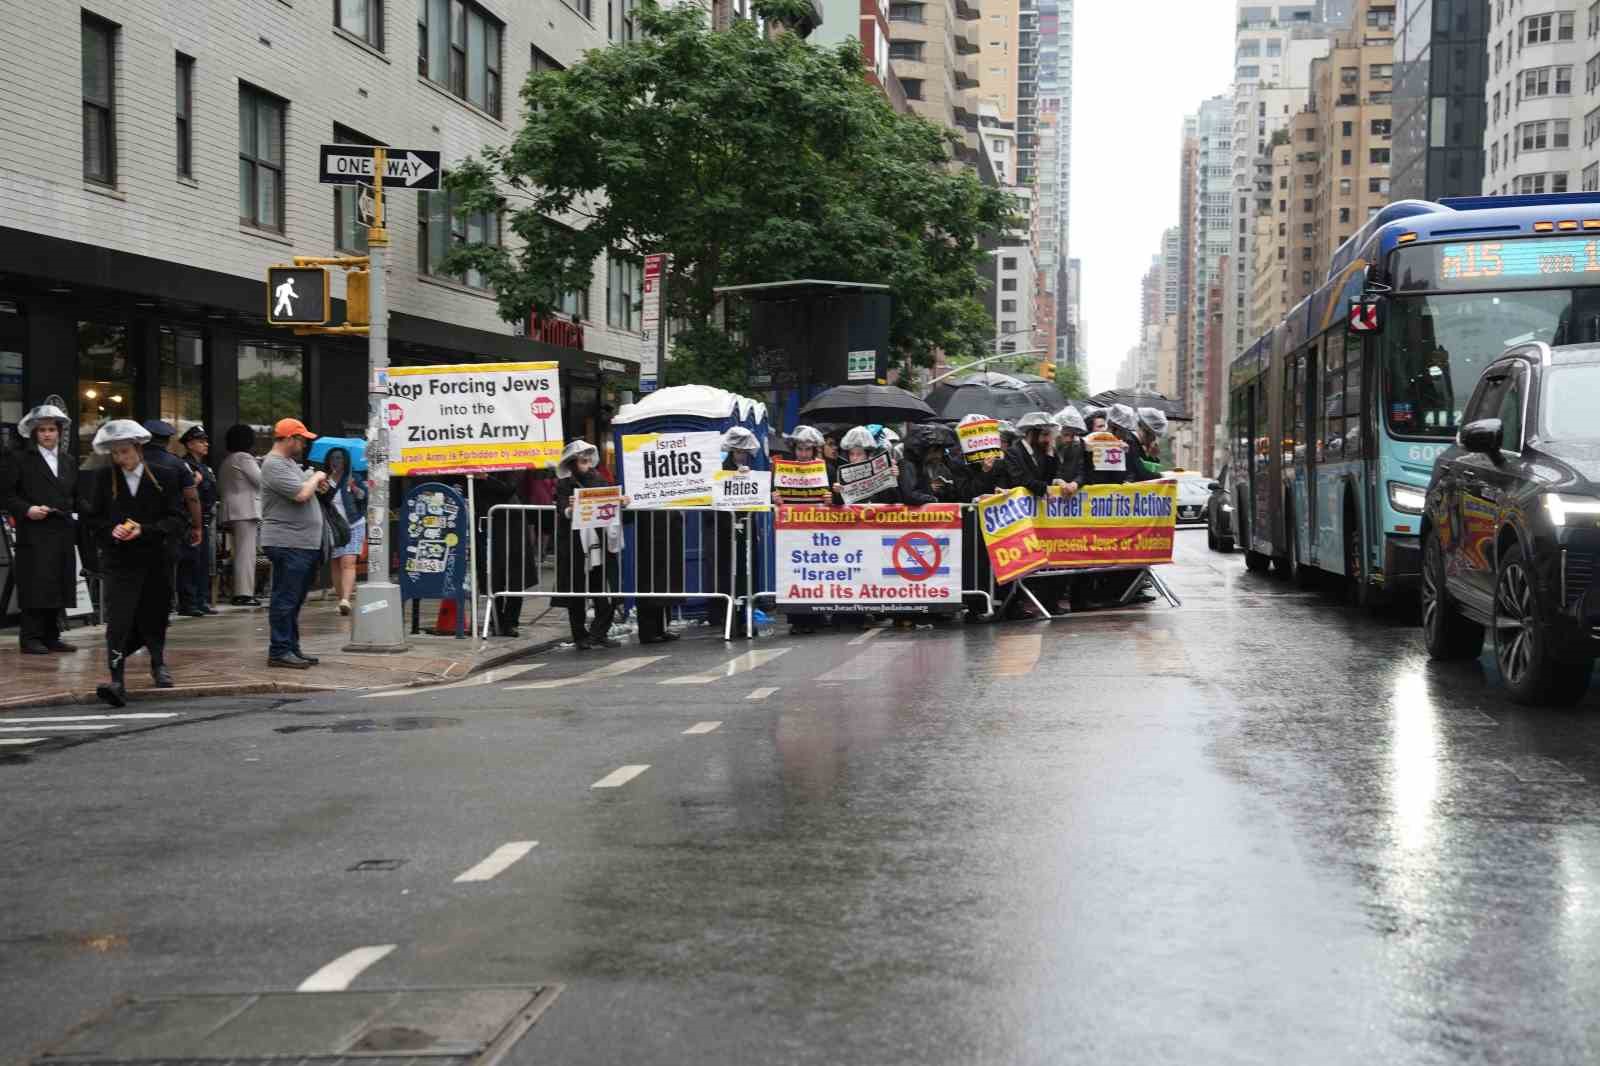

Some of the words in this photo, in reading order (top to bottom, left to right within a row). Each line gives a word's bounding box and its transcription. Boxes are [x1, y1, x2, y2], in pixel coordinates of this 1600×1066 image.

[337, 158, 371, 174] ONE
[387, 160, 422, 176] WAY
[429, 377, 496, 396] Forcing
[502, 376, 550, 392] Jews
[440, 403, 467, 416] into
[472, 402, 495, 414] the
[407, 423, 473, 442] Zionist
[479, 422, 529, 440] Army
[656, 437, 687, 450] Israel
[643, 450, 702, 479] Hates
[724, 480, 759, 496] Hates
[1091, 493, 1112, 516] and
[1116, 493, 1131, 516] its
[1133, 492, 1172, 516] Actions
[783, 507, 855, 523] Judaism
[860, 507, 954, 523] Condemns
[812, 532, 841, 546] the
[791, 549, 840, 564] State
[844, 549, 864, 563] of
[995, 547, 1022, 567] Do
[1040, 536, 1088, 554] epresent
[793, 567, 861, 581] "Israel"
[788, 583, 823, 599] And
[829, 583, 854, 599] its
[859, 583, 950, 599] Atrocities
